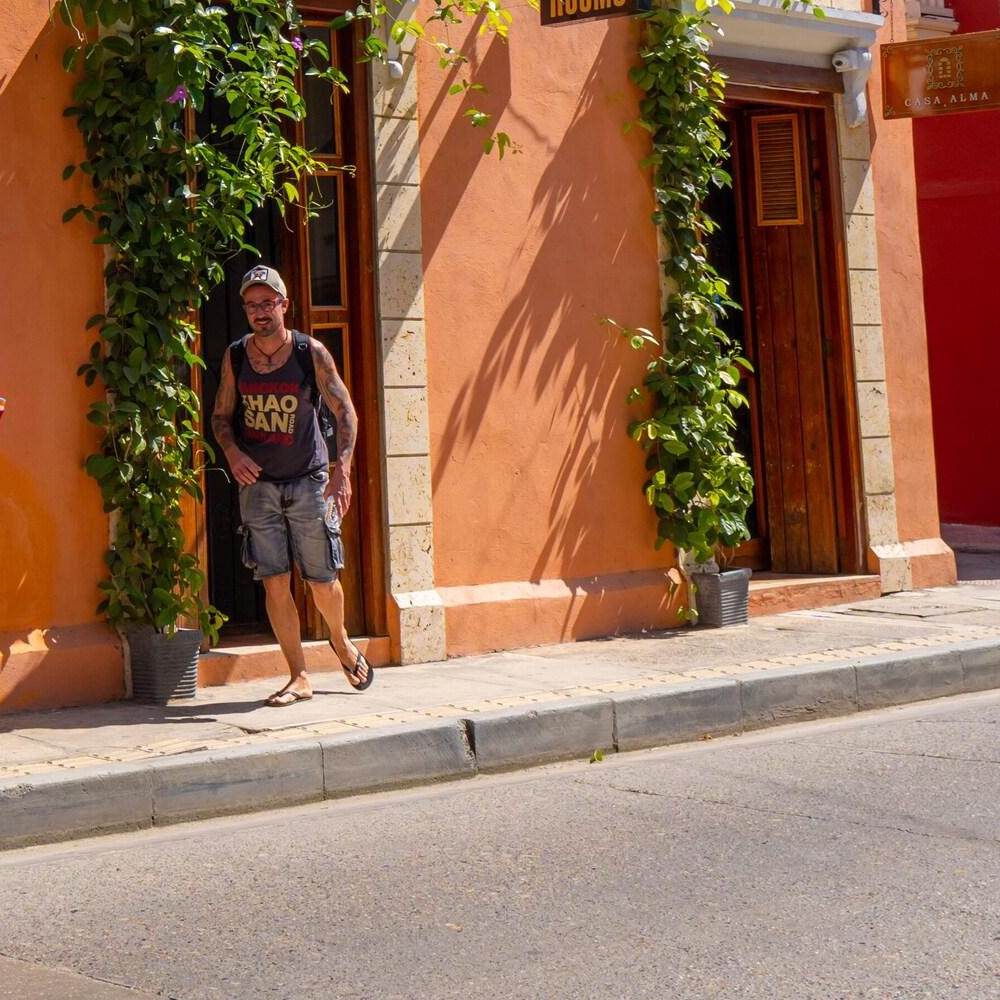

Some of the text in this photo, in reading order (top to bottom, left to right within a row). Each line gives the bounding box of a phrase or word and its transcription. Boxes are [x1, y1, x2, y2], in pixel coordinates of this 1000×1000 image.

[904, 91, 989, 107] CASA ALMA
[244, 409, 289, 433] SAN
